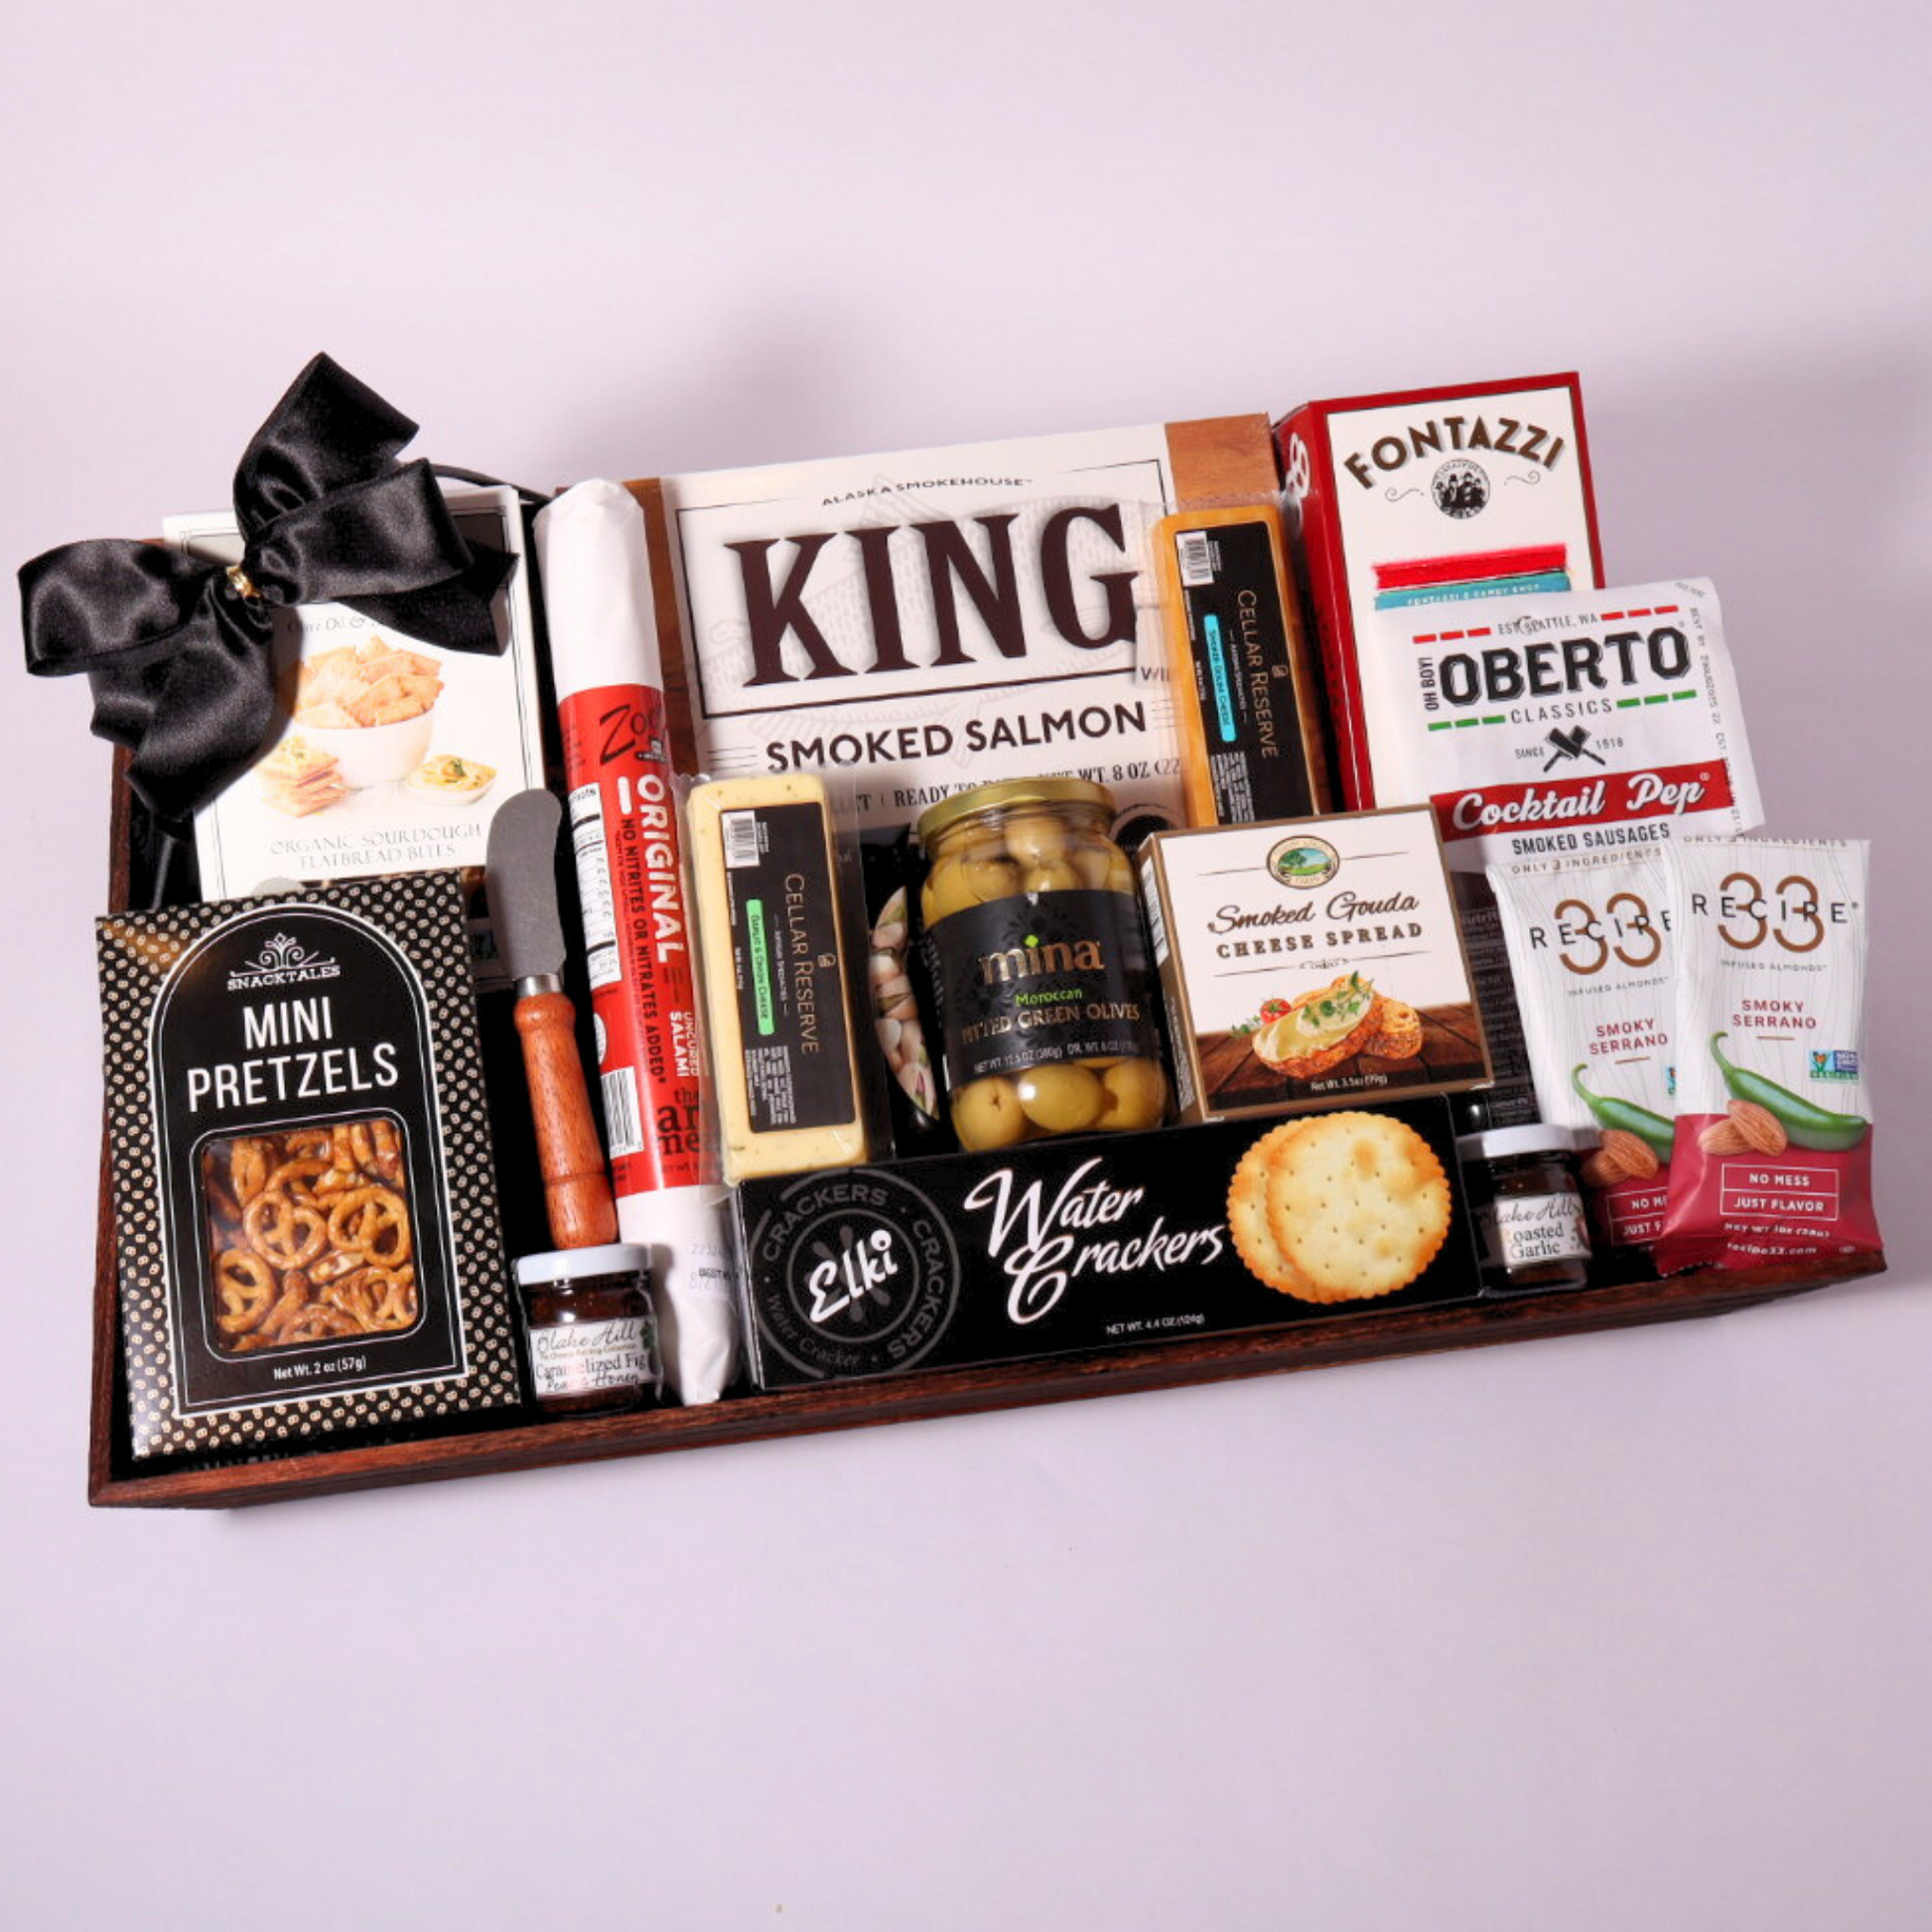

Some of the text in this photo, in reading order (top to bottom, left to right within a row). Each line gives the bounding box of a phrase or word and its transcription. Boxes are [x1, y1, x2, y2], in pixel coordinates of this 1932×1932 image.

[1343, 415, 1565, 489] FONTAZZI
[821, 485, 893, 505] ALASKA
[723, 503, 1142, 688] KING
[1579, 613, 1597, 625] WA
[1238, 590, 1278, 759] CELLAR RESERVE
[1418, 655, 1440, 712] OH BOY!
[1439, 626, 1692, 709] OBERTO
[1510, 698, 1612, 724] CLASSICS
[765, 700, 1147, 772] SMOKED SALMON
[1515, 747, 1545, 759] SINCE
[1113, 764, 1124, 781] 8
[1451, 780, 1606, 831] Cocktail
[621, 819, 636, 842] NO
[1511, 822, 1671, 856] SMOKED SAUSAGES
[624, 846, 645, 913] NITRITES
[637, 773, 685, 963] ORIGINAL
[1511, 865, 1549, 875] ONLY
[633, 918, 648, 939] OR
[1207, 891, 1420, 935] Smoked Gouda
[1216, 922, 1423, 959] CHEESE SPREAD
[785, 873, 819, 1053] CELLAR RESERVE
[978, 934, 1105, 985] mina
[227, 965, 341, 991] SNACKTALES
[637, 945, 657, 1020] NITRATES
[1015, 988, 1082, 1008] Moroccan
[1741, 1000, 1804, 1013] SMOKY
[243, 997, 333, 1049] MINI
[1017, 1007, 1080, 1031] GREEN
[1086, 1003, 1140, 1022] OLIVES
[1596, 1018, 1654, 1037] SMOKY
[1732, 1015, 1817, 1029] SERRANO
[669, 1012, 691, 1077] SALAMI
[1589, 1034, 1668, 1055] SERRANO
[187, 1042, 398, 1113] PRETZELS
[1749, 1173, 1810, 1186] NO MESS
[963, 1156, 1145, 1258] Water
[1631, 1196, 1649, 1209] NO
[1733, 1197, 1825, 1212] JUST FLAVOR
[762, 1183, 888, 1262] CRACKERS
[1502, 1222, 1565, 1242] oasted
[809, 1229, 898, 1323] Elki
[1004, 1216, 1226, 1324] Crackers
[888, 1219, 944, 1358] CRACKERS
[592, 1318, 638, 1347] Hill
[273, 1355, 366, 1381] Net Wt. 2 oz (57g)
